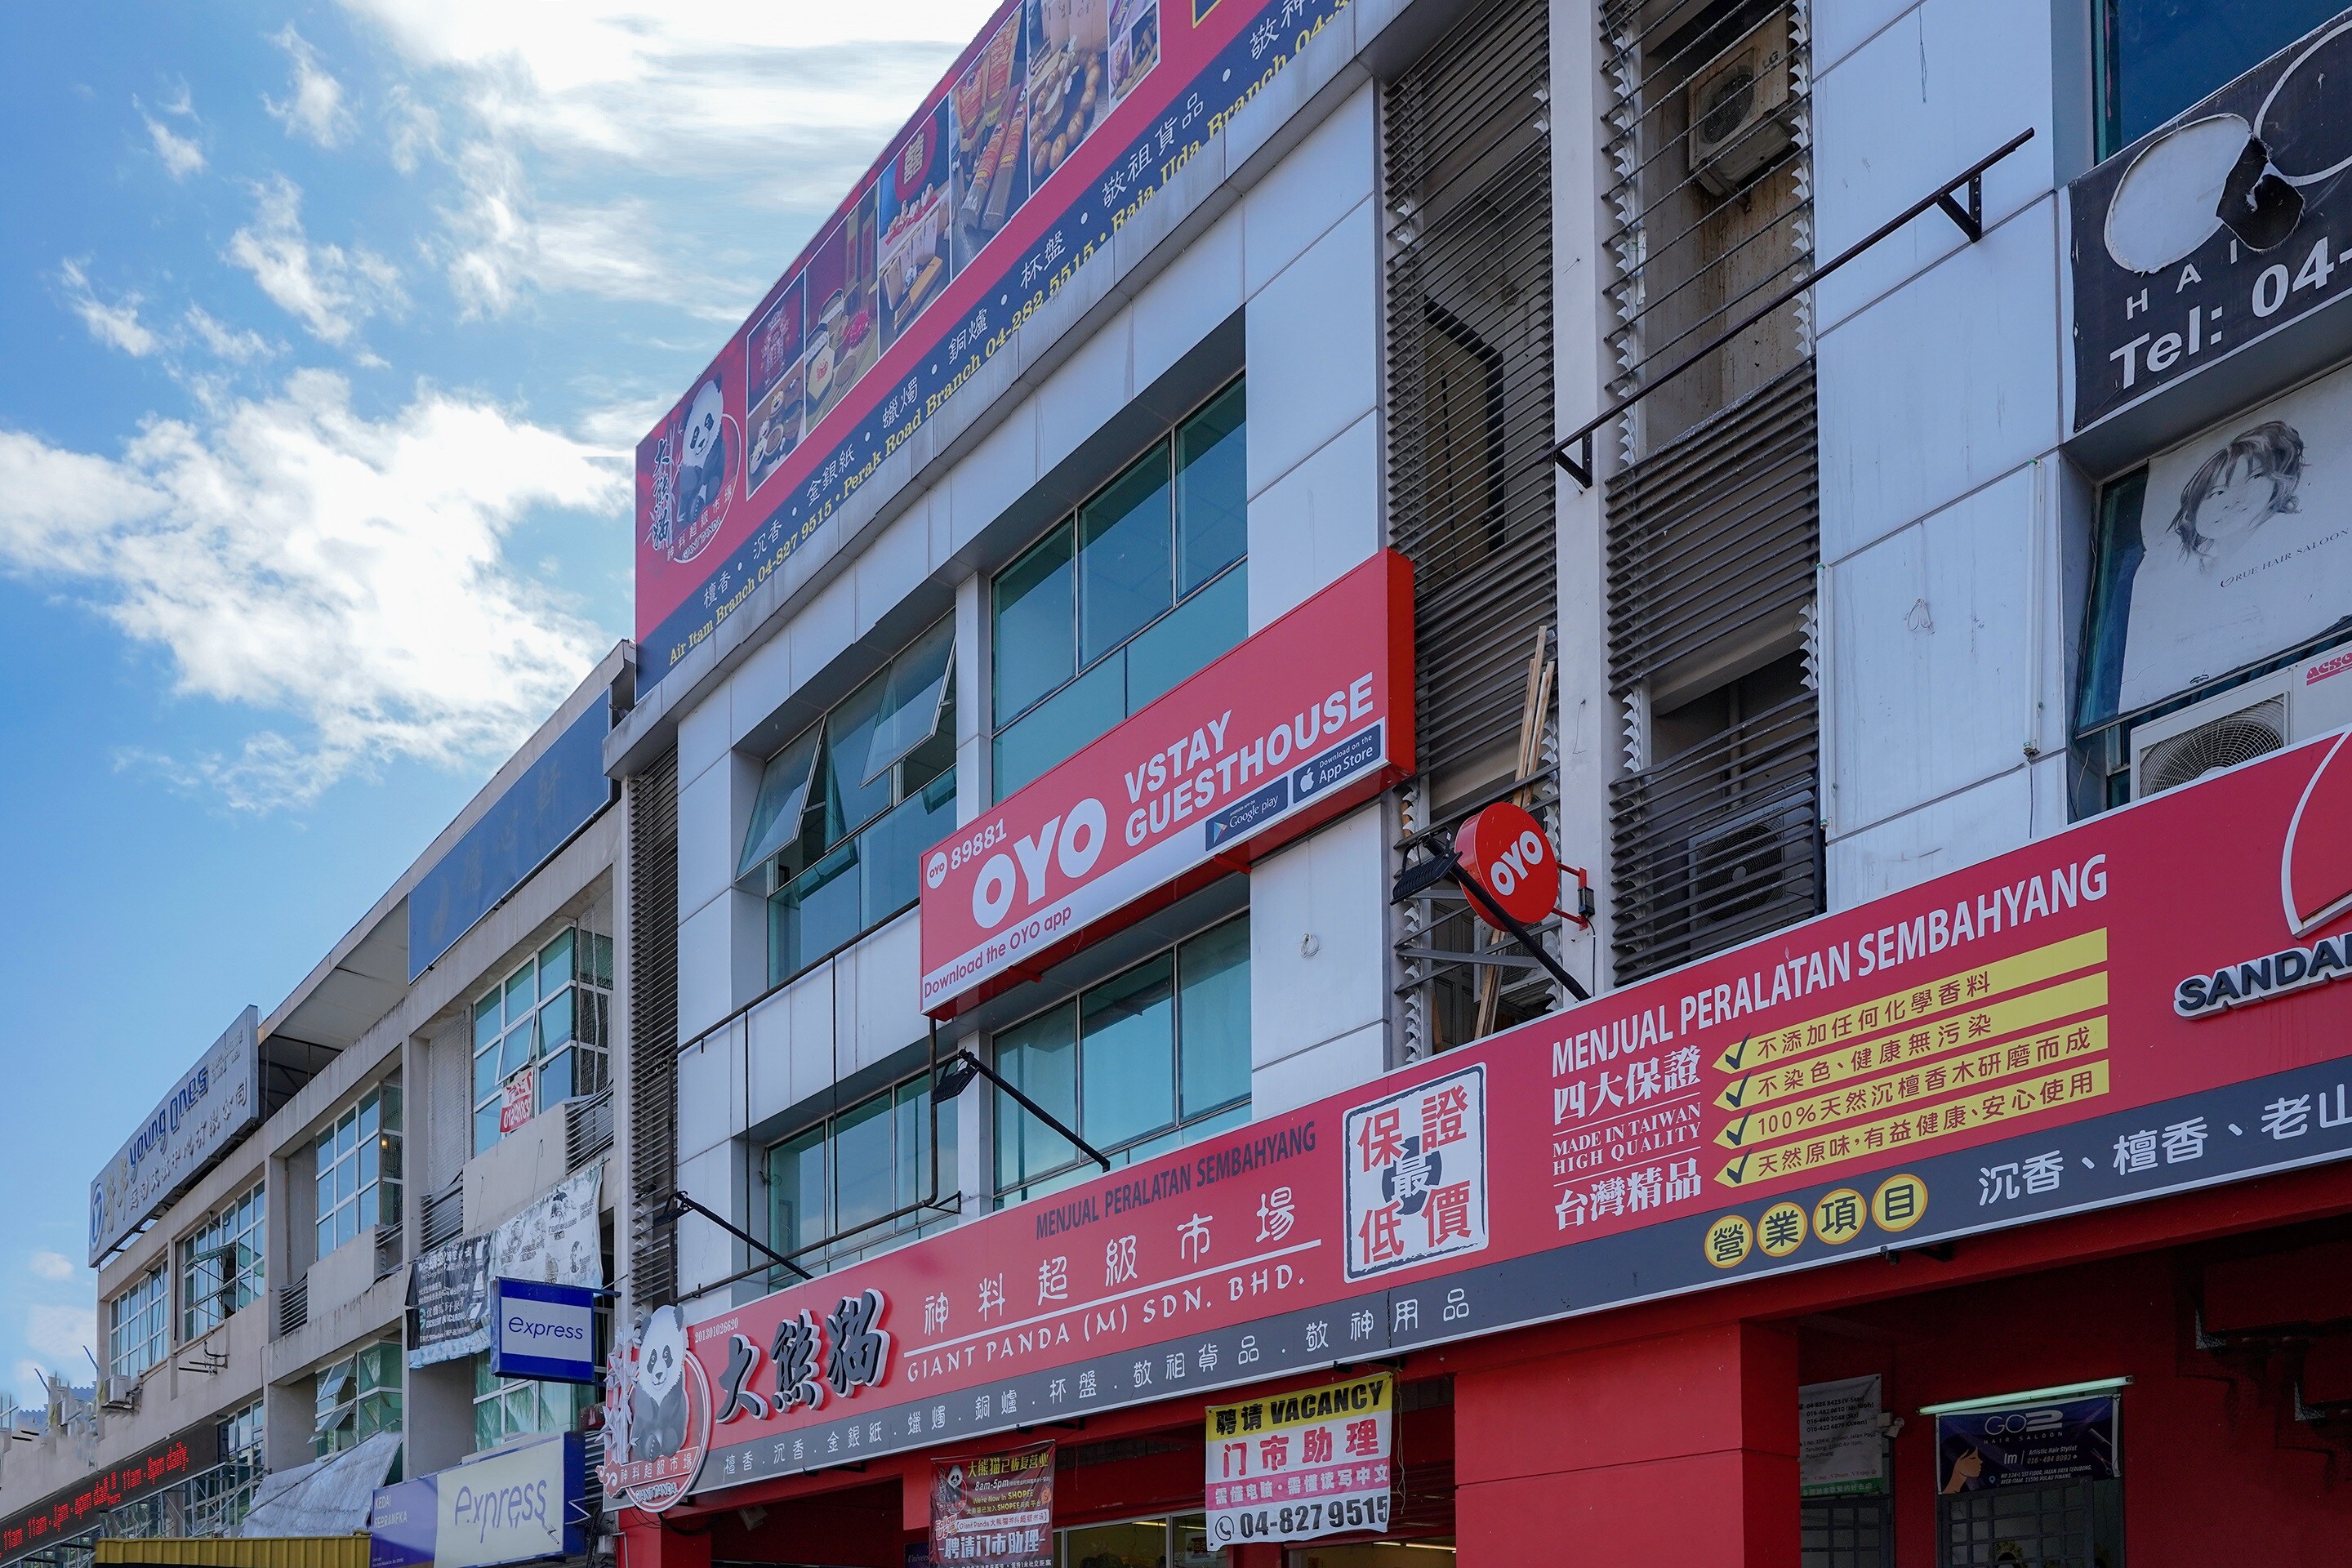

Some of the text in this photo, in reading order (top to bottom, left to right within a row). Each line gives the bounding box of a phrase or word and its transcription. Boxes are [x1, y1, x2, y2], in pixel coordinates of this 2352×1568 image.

[669, 642, 687, 666] Air
[715, 577, 755, 625] Branch
[758, 539, 799, 583] 04-827
[801, 502, 833, 542] 9515
[844, 450, 883, 498] Perak
[885, 408, 923, 457] Road
[925, 355, 982, 416] Branch
[985, 289, 1044, 359] 04-282
[1049, 240, 1095, 296] 5515
[1207, 54, 1288, 140] Branch
[2109, 305, 2224, 390] Tel:
[806, 443, 856, 506] 金銀紙
[752, 520, 782, 560] 沉香
[2262, 552, 2292, 570] HAIR
[2296, 527, 2350, 555] SALOON
[703, 570, 732, 609] 檀香
[1124, 709, 1232, 804] VSTAY
[1124, 670, 1374, 848] GUESTHOUSE
[1319, 734, 1373, 768] Download on the
[1319, 746, 1374, 784] App Store
[1229, 794, 1279, 828] Google play
[929, 817, 1007, 879] OYO 89881
[972, 797, 1107, 929] OYO
[1490, 830, 1544, 896] OYO
[924, 906, 1071, 999] Download the OYO app
[1552, 853, 2107, 1078] MENJUAL PERALATAN SEMBAHYANG
[2178, 933, 2352, 1011] SANDA
[1757, 970, 1991, 1060] 不添加任何化學香料
[1553, 1045, 1702, 1125] 四大保證
[1552, 1102, 1702, 1158] MADE IN TAIWAN
[1552, 1121, 1702, 1176] HIGH QUALITY
[1036, 1121, 1316, 1241] MENJUAL PERALATAN SEMBAHYANG
[1554, 1156, 1702, 1231] 台灣精品
[1713, 1183, 1915, 1263] 營業項目
[509, 1316, 583, 1339] express
[906, 1264, 1305, 1383] GIANT PANDA (M) SDN. BHD.
[773, 1438, 804, 1464] 沉香
[826, 1420, 882, 1454] 金銀紙
[1306, 1288, 1470, 1352] 敬神用品
[1215, 1380, 1383, 1435] 聘请 VACANCY
[1984, 1410, 2064, 1436] GO2
[2019, 1432, 2063, 1441] SALOON
[1223, 1419, 1379, 1478] 门市助理
[2029, 1447, 2047, 1455] Artistic
[2060, 1445, 2078, 1453] Stylist
[375, 1494, 391, 1509] KEDAI
[975, 1479, 1009, 1491] 8am-5pm
[1008, 1489, 1034, 1499] SHOPEE
[1240, 1495, 1388, 1538] 04-827 9515
